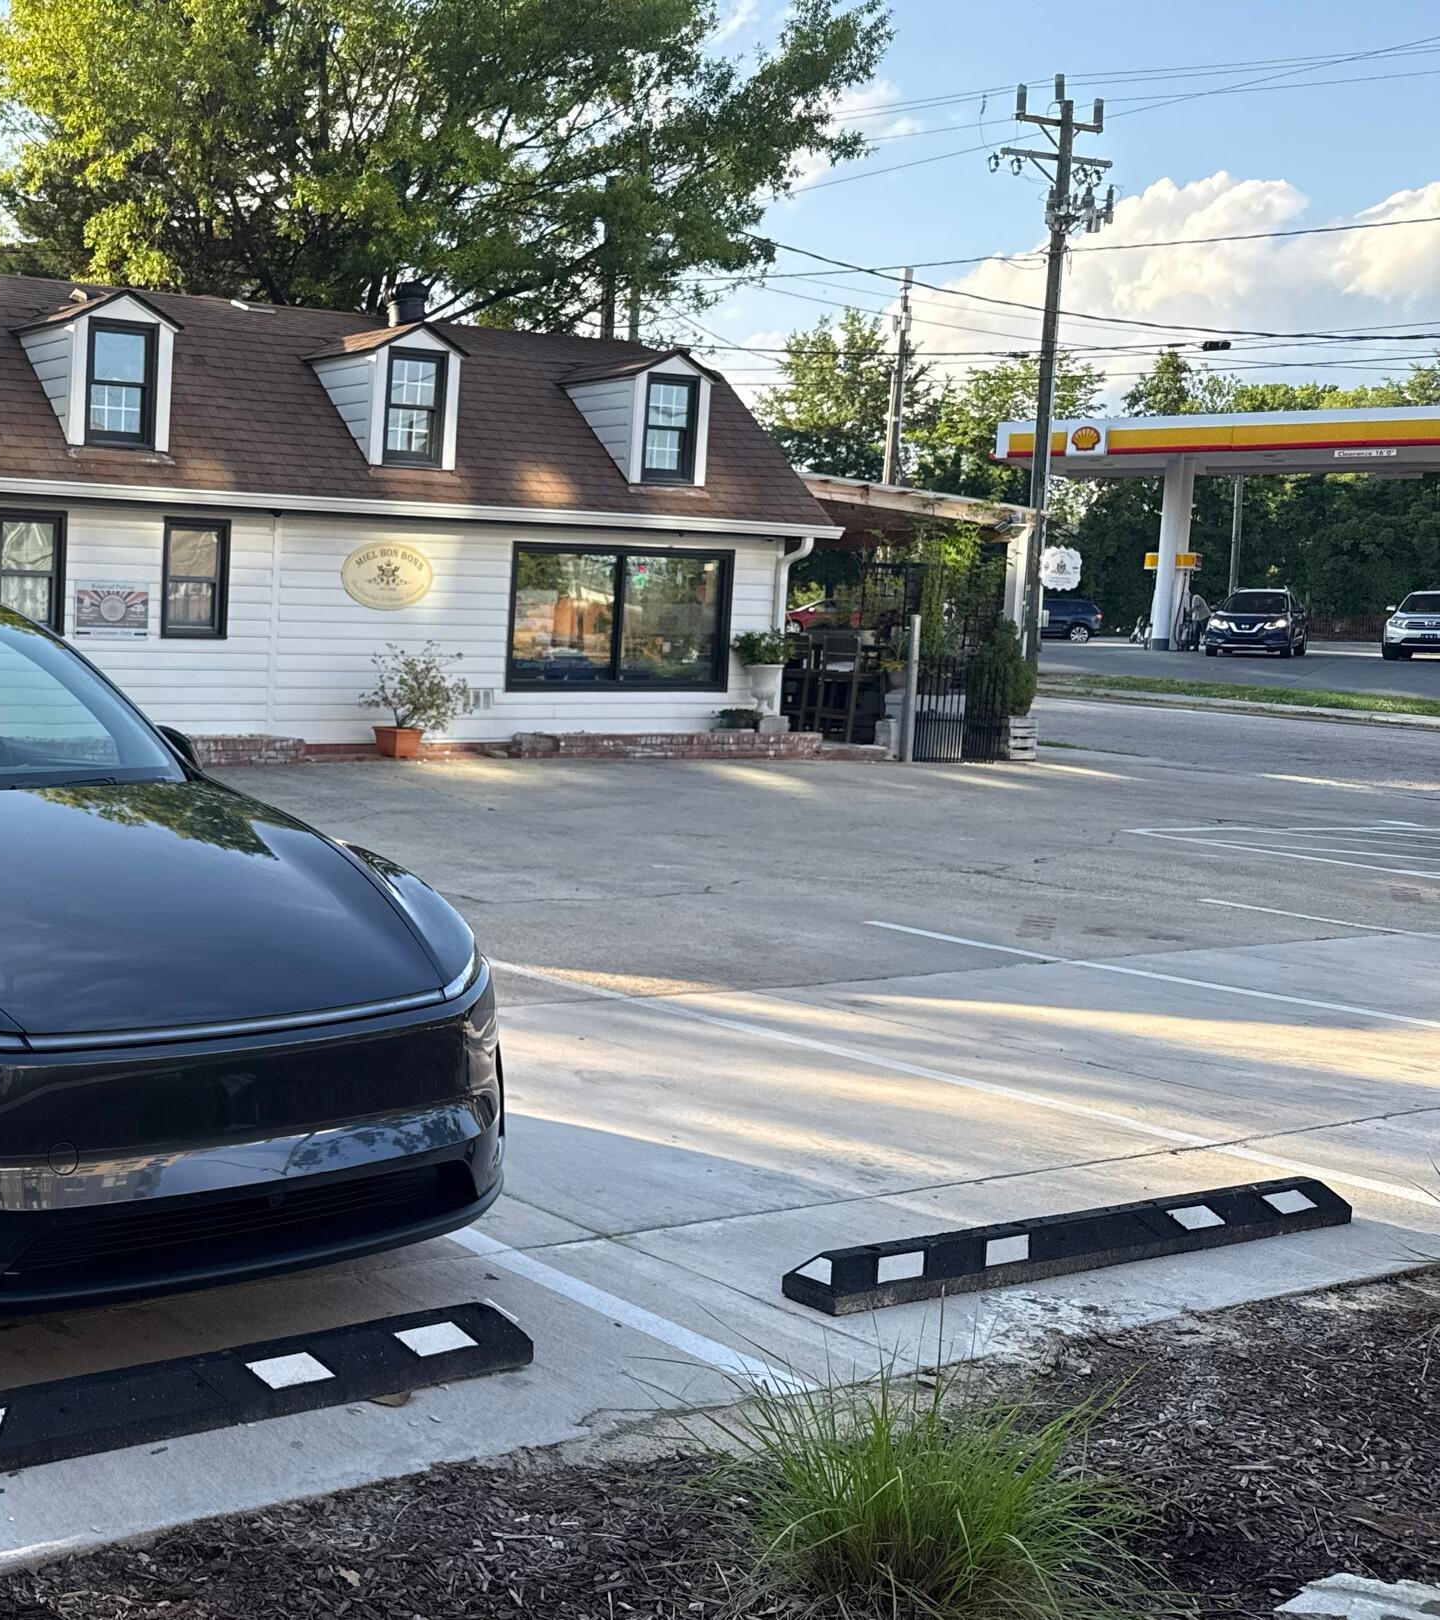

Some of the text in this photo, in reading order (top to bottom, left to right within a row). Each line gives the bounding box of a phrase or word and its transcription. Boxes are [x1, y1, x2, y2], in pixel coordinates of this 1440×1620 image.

[355, 548, 425, 571] MIEL BON BONS
